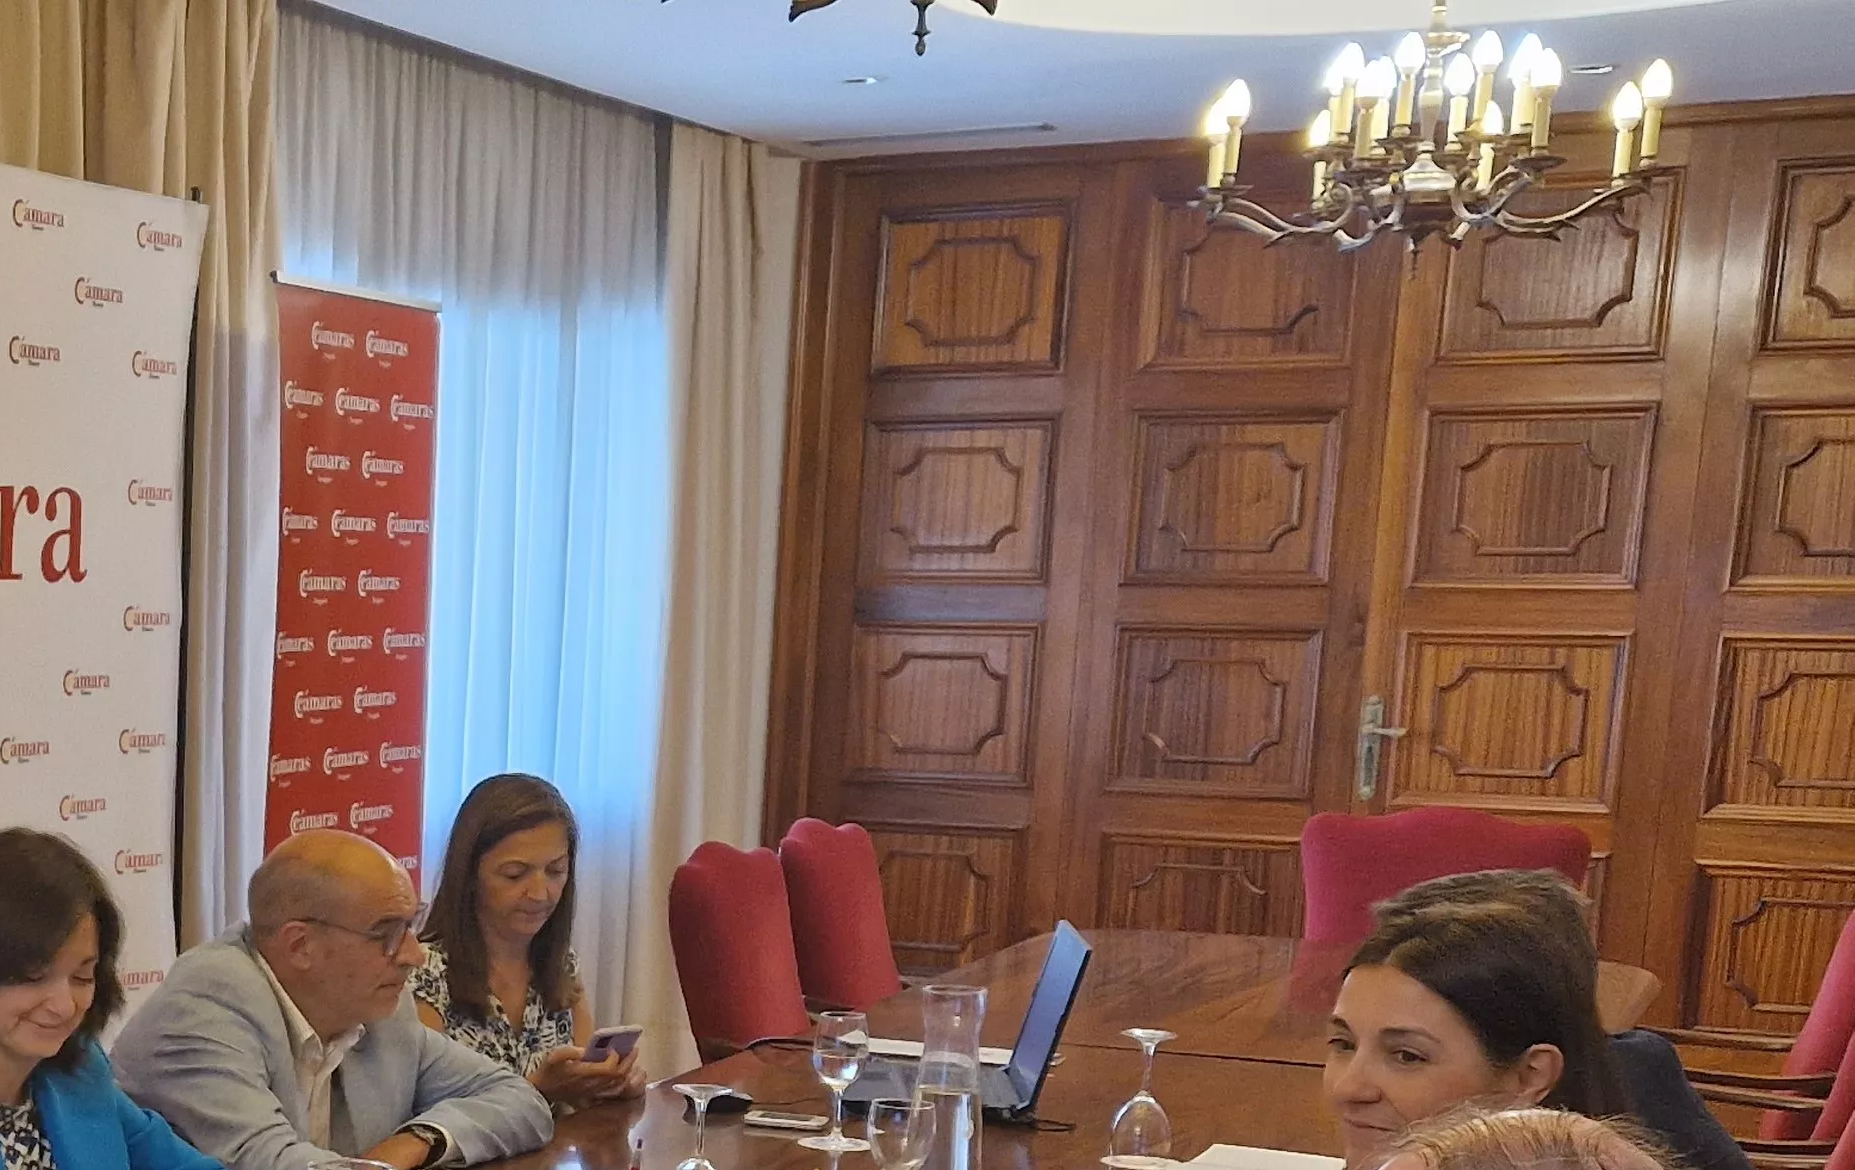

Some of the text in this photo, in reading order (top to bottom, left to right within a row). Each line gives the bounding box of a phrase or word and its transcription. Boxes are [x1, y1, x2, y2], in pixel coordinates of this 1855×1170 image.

[12, 199, 64, 231] Cámara
[7, 335, 60, 364] Cámara
[0, 736, 50, 765] Cámara
